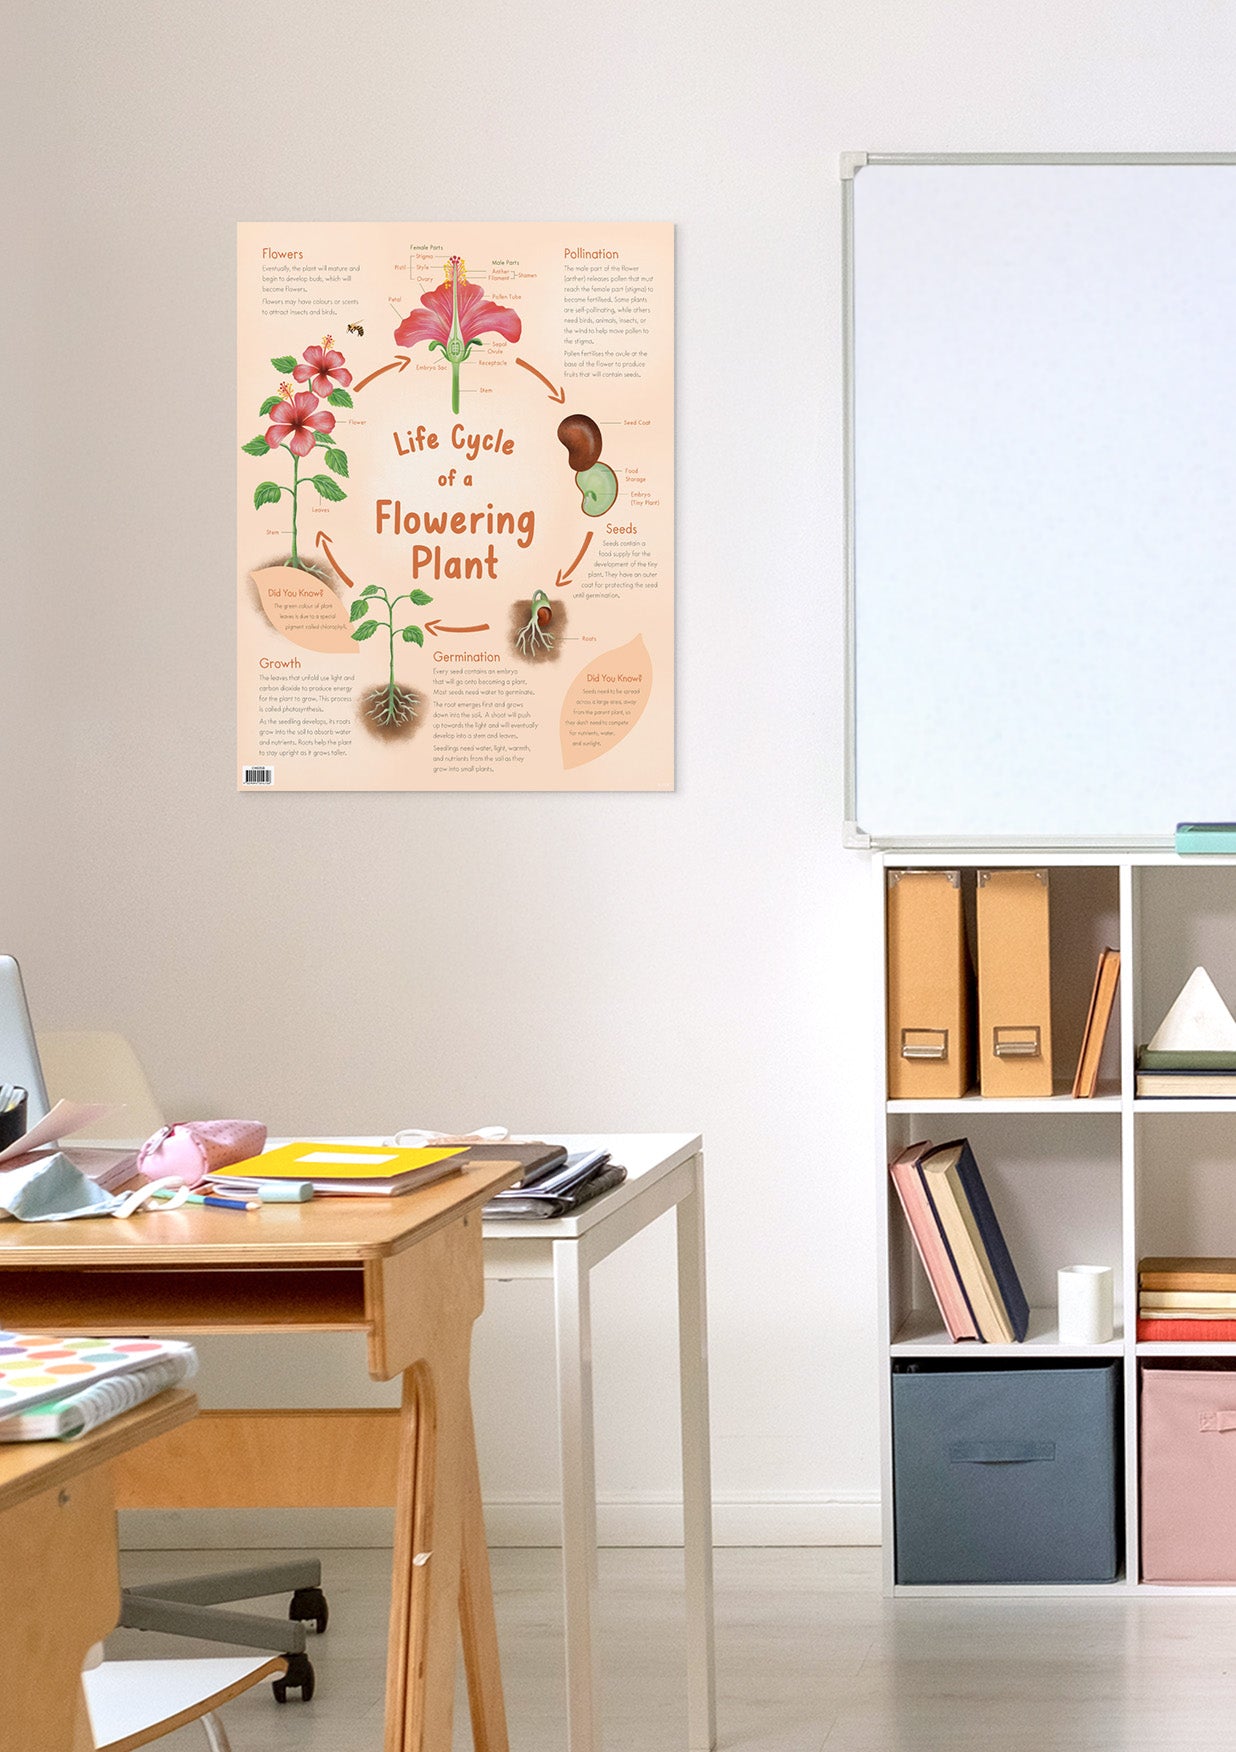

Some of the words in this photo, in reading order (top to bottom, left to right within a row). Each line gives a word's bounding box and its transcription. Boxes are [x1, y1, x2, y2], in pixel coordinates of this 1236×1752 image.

[263, 248, 303, 259] Flowers
[564, 248, 619, 259] Pollination
[302, 265, 316, 273] plant
[590, 265, 602, 273] part
[262, 275, 278, 283] begin
[286, 275, 308, 283] develop
[610, 275, 627, 283] pollen
[611, 286, 624, 294] part
[393, 426, 439, 456] Life
[452, 424, 514, 461] Cycle
[438, 468, 456, 486] of
[464, 475, 472, 486] a
[376, 499, 535, 549] Flowering
[606, 522, 637, 534] Seeds
[613, 551, 631, 559] supply
[412, 544, 498, 580] Plant
[594, 560, 628, 569] development
[648, 560, 658, 569] tiny
[605, 571, 618, 579] They
[605, 582, 634, 590] protecting
[268, 588, 281, 597] Did
[283, 589, 297, 597] You
[298, 589, 324, 598] Know?
[433, 651, 500, 662] Germination
[259, 657, 301, 668] Growth
[433, 668, 448, 676] Every
[496, 668, 518, 676] embryo
[330, 674, 342, 683] light
[587, 674, 600, 682] Did
[602, 674, 616, 683] You
[617, 674, 642, 682] Know?
[279, 696, 293, 704] plant
[433, 745, 459, 753] Seedlings
